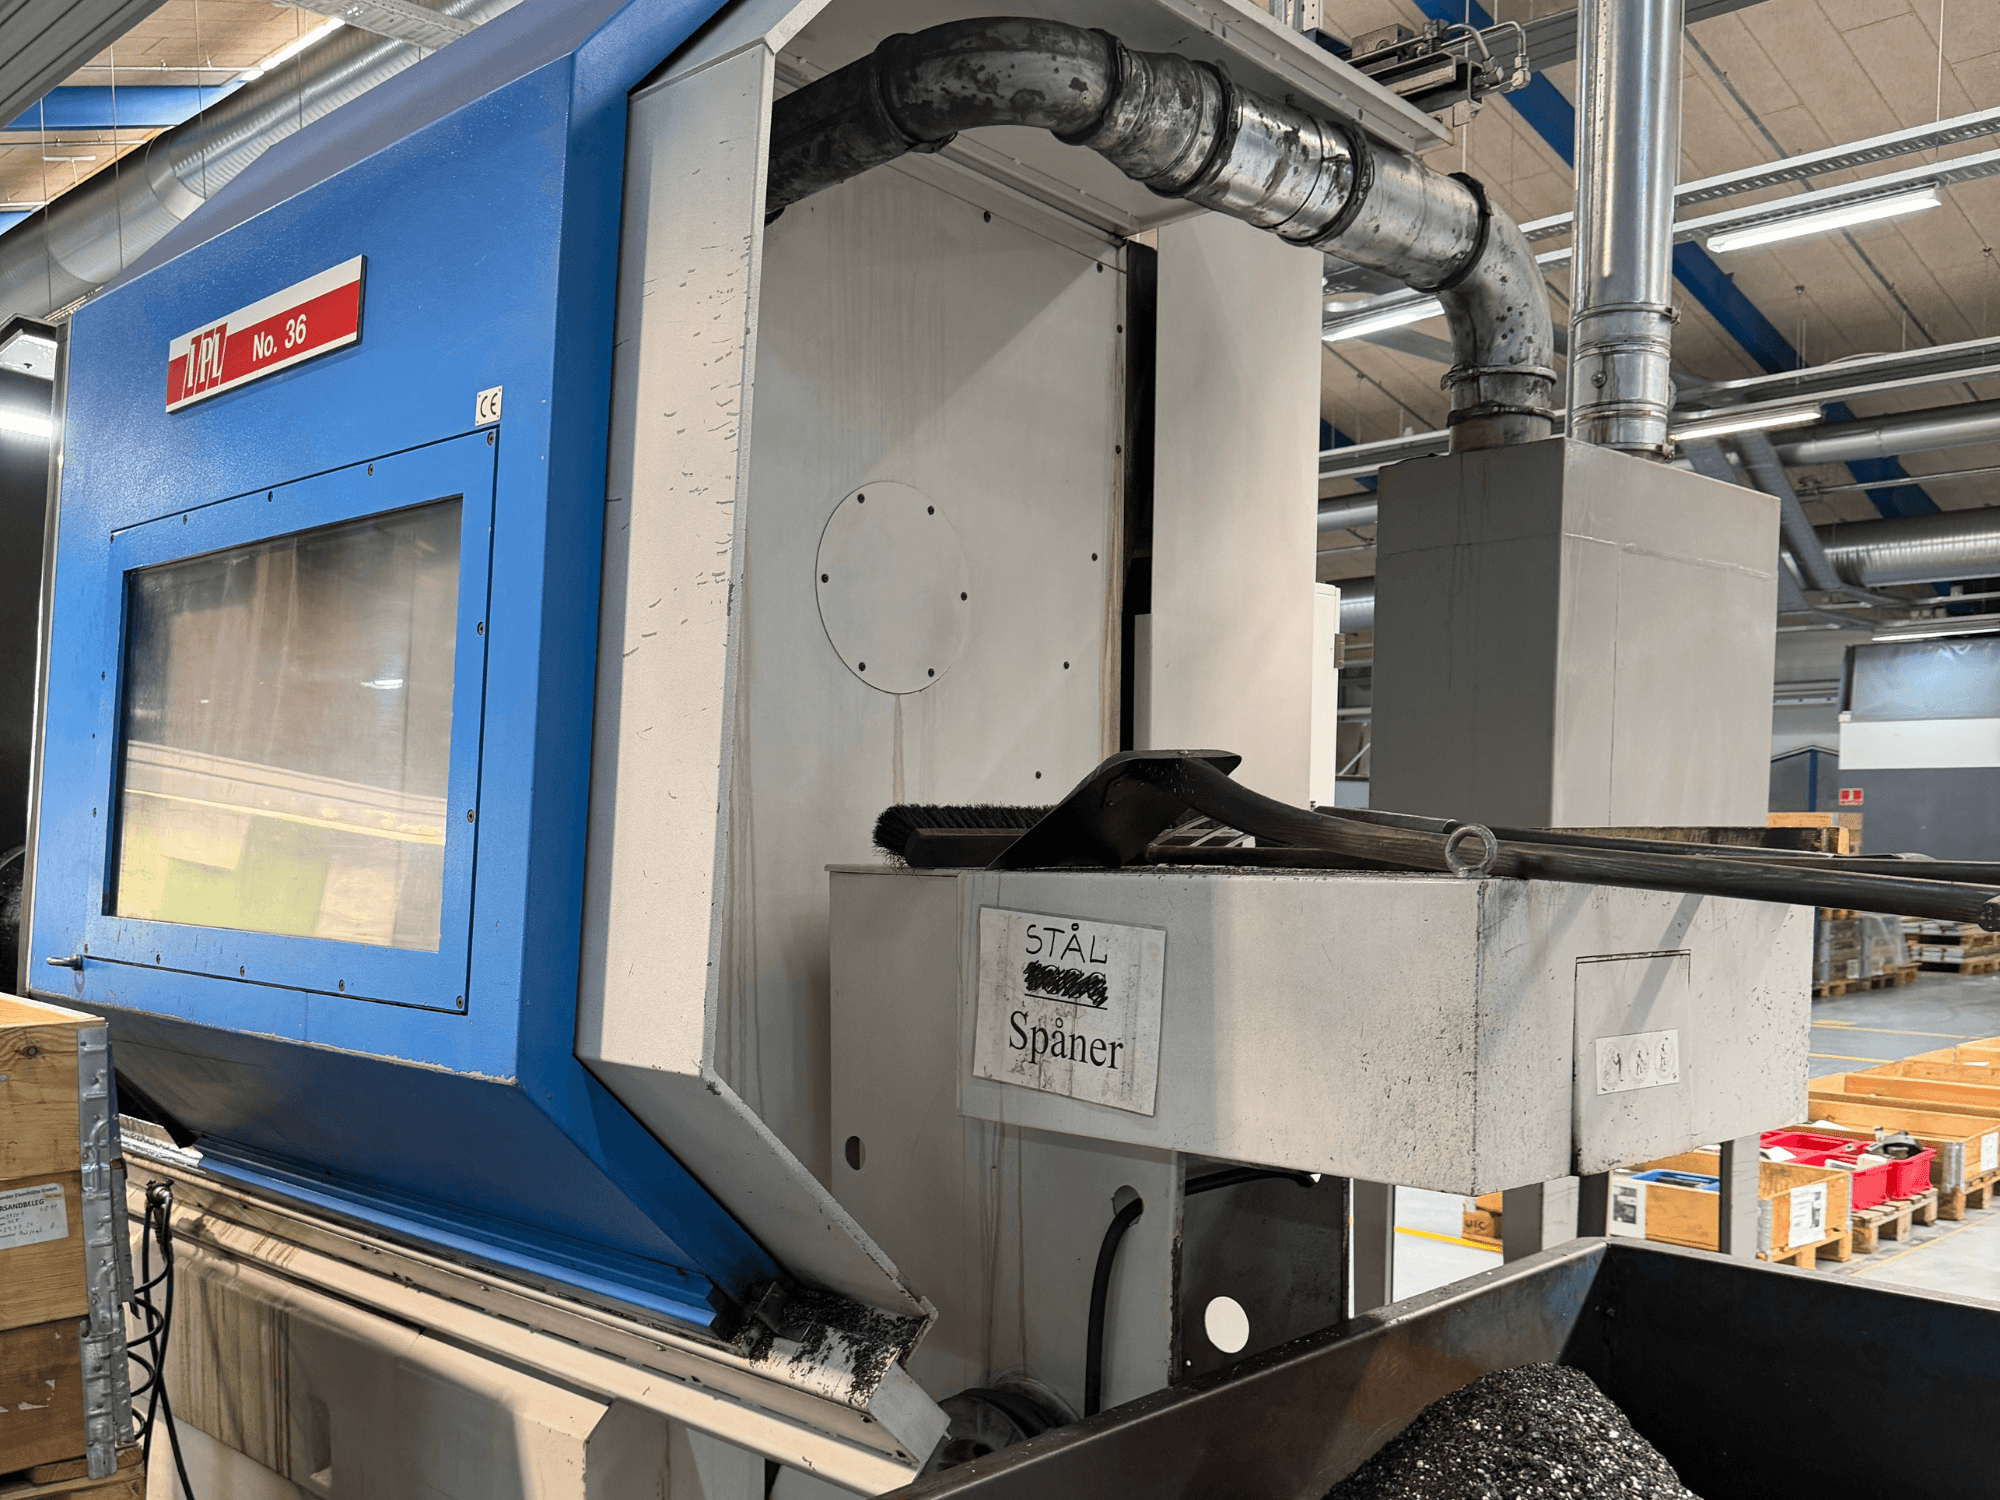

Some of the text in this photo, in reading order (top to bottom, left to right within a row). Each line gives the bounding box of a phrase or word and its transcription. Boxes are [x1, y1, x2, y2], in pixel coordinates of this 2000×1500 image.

[253, 331, 277, 362] No.
[285, 313, 307, 349] 36
[480, 392, 498, 418] CE
[1026, 922, 1108, 964] STÅL
[1009, 1010, 1124, 1070] Spåner
